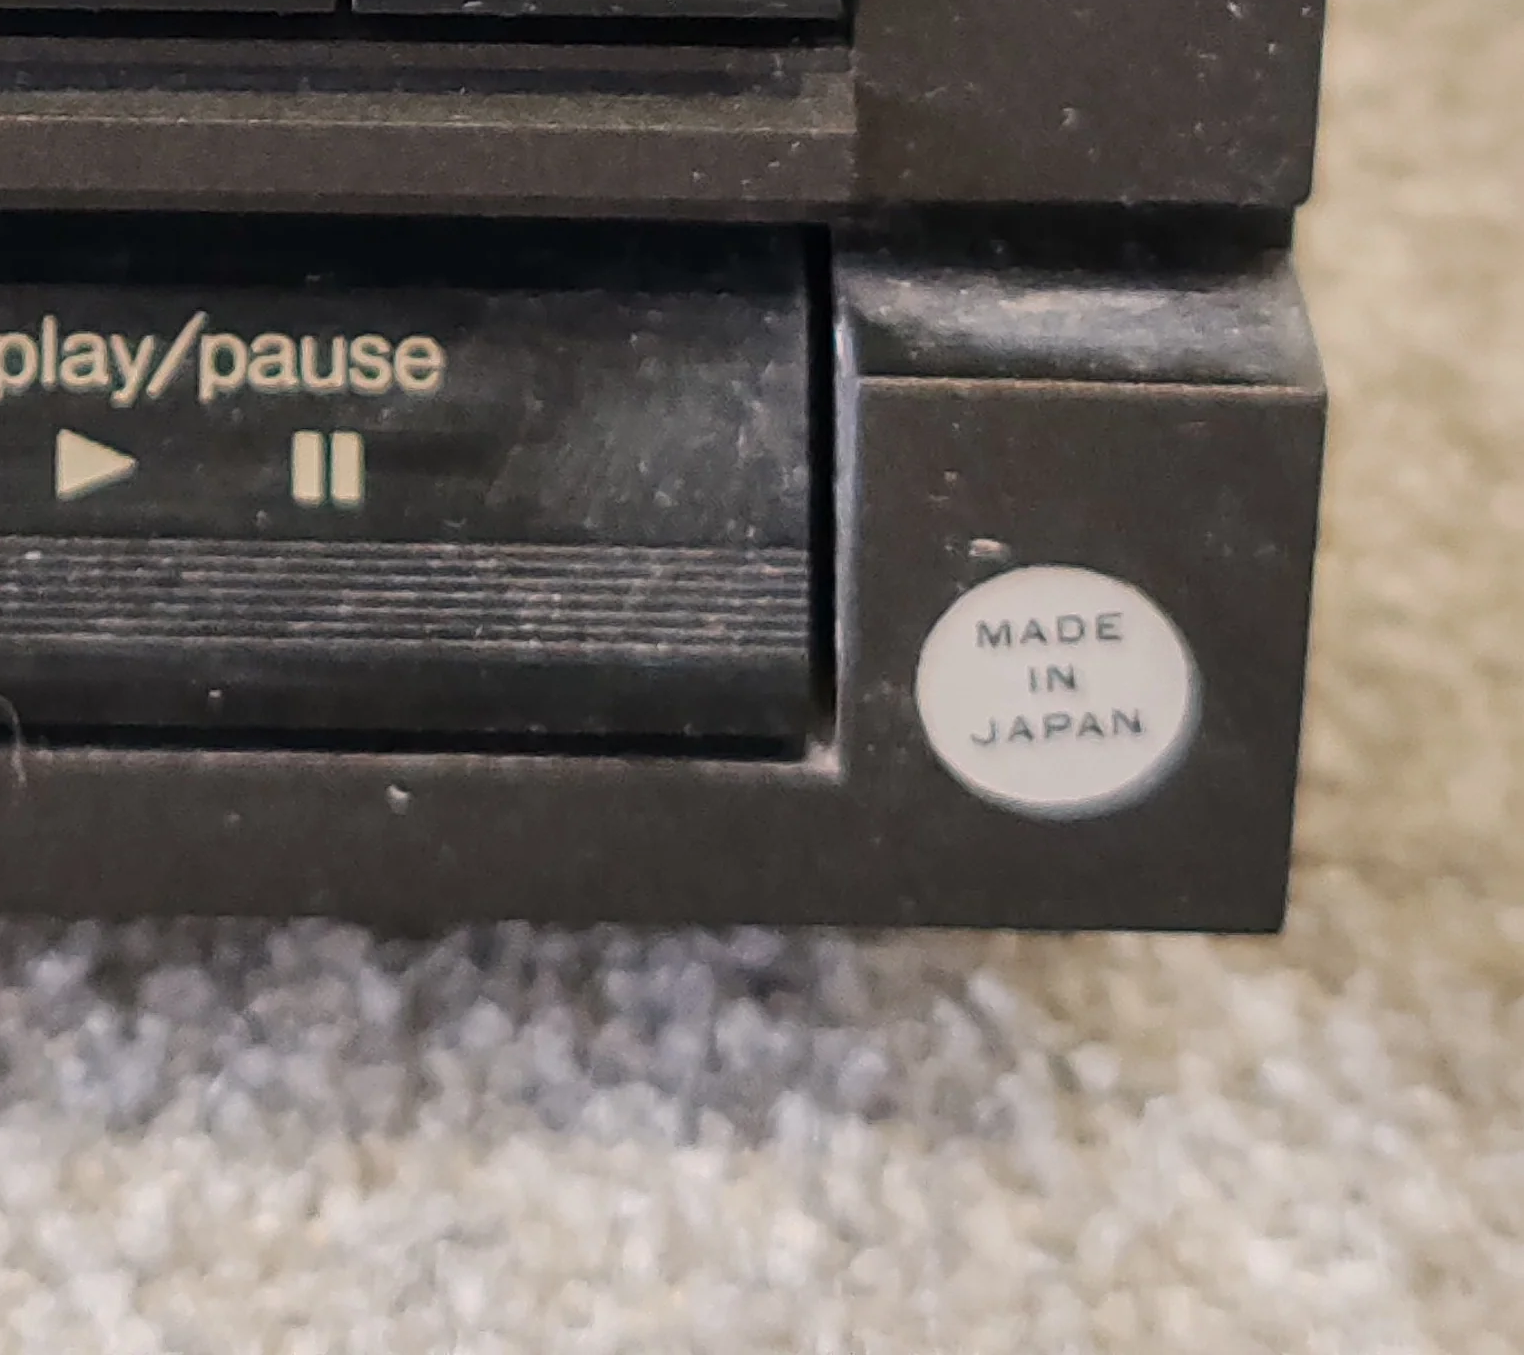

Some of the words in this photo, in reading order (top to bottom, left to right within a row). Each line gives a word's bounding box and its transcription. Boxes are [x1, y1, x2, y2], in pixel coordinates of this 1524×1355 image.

[975, 611, 1126, 649] MADE
[1026, 664, 1078, 693] IN
[970, 708, 1144, 746] JAPAN
